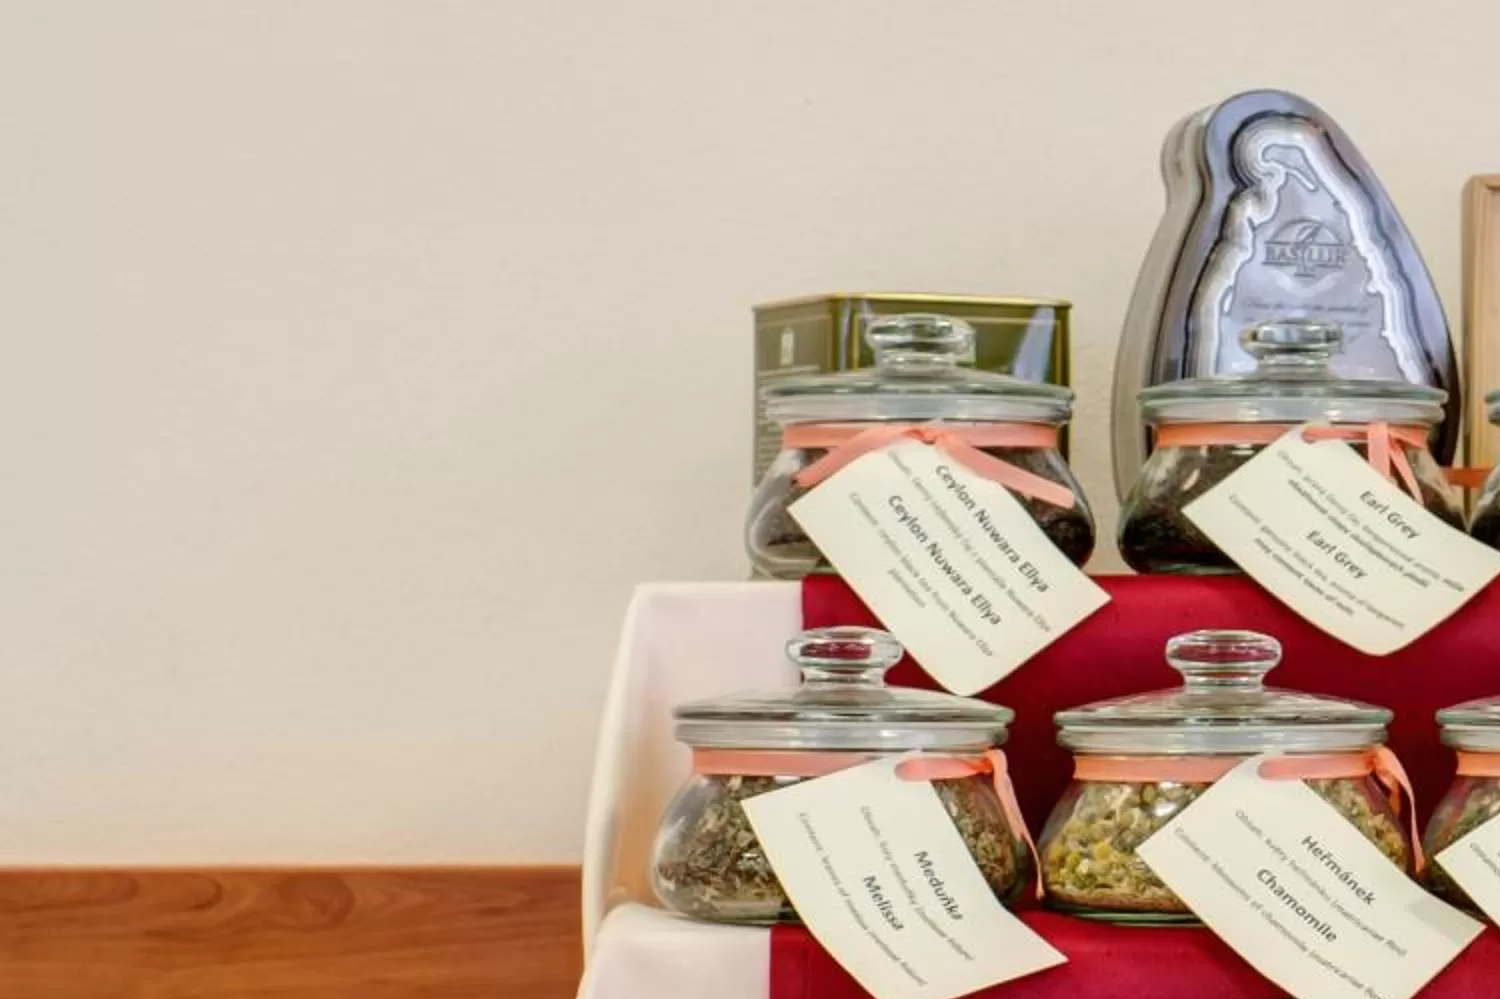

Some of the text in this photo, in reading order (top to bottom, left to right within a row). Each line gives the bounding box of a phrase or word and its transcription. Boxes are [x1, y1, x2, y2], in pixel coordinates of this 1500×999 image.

[887, 494, 928, 543] Ceylon
[925, 541, 973, 595] Nuwara
[934, 464, 976, 511] Ceylon
[973, 508, 1020, 564] Nuwara
[1358, 489, 1420, 539] Earl Grey
[1305, 529, 1367, 579] Earl Grey
[862, 875, 904, 931] Melissa
[1256, 868, 1337, 942] Chamomile
[1300, 835, 1375, 905] Heřmánek
